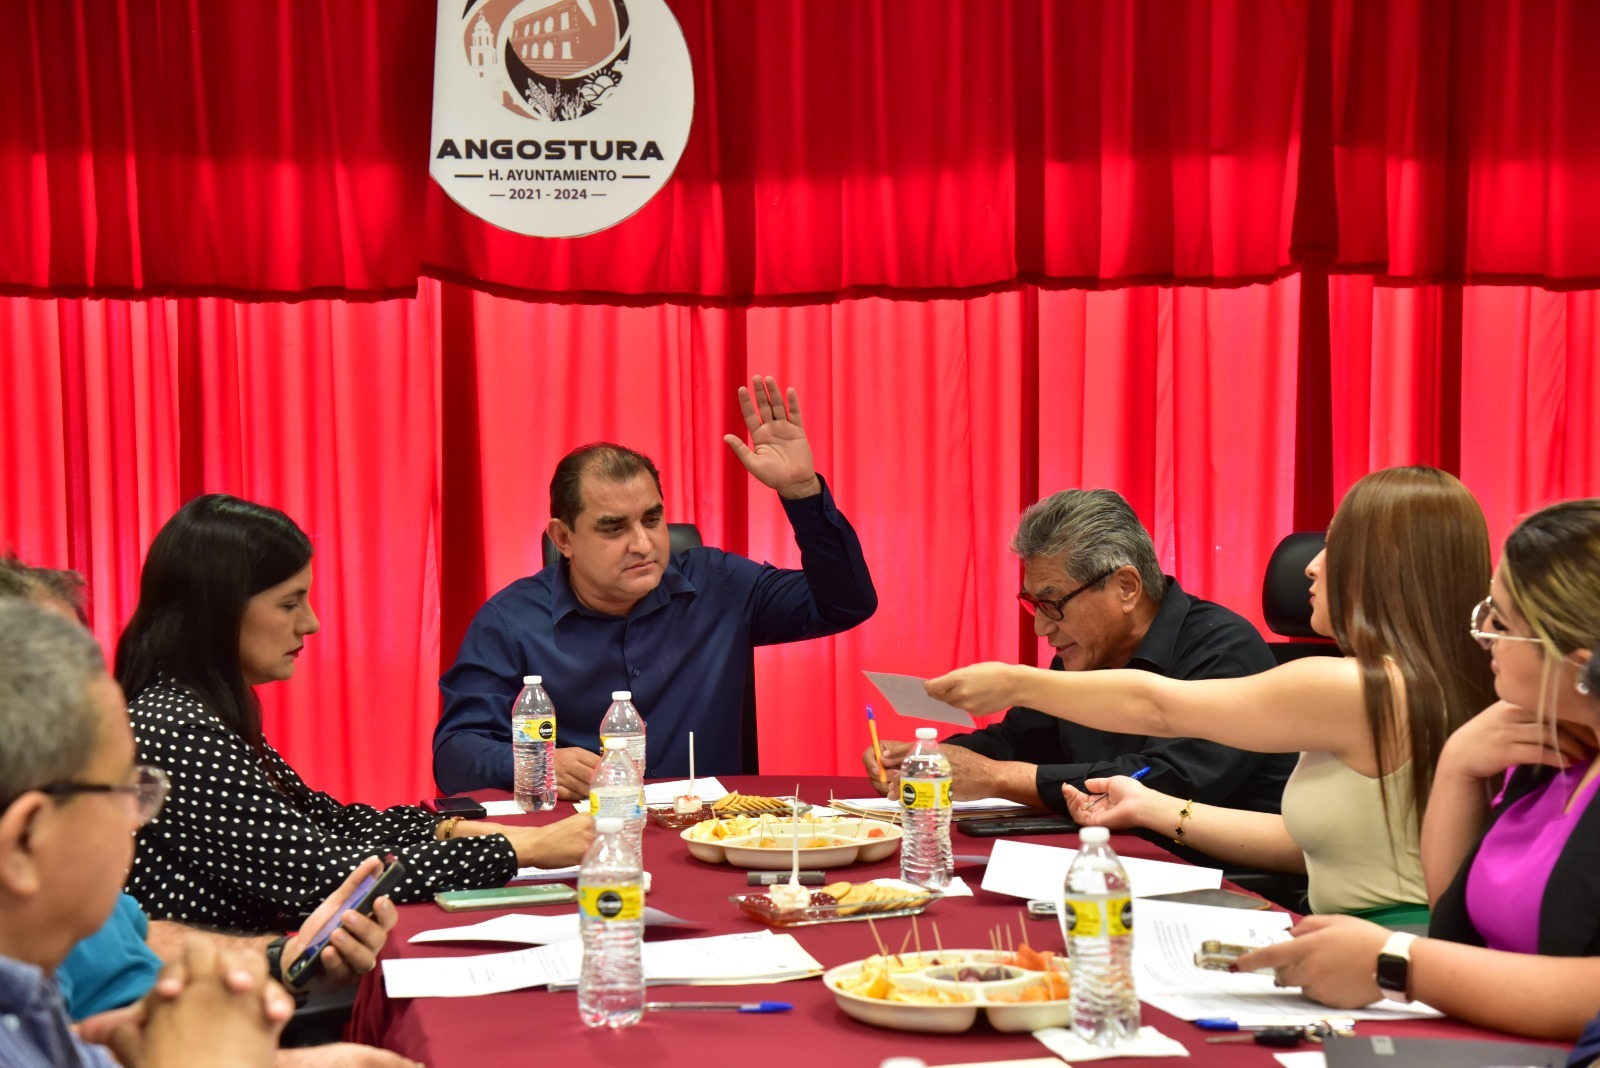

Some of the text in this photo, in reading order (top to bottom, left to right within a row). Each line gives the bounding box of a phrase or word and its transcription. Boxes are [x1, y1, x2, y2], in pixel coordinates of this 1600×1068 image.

[436, 138, 664, 161] ANGOSTURA
[488, 169, 617, 182] H. AYUNTAMIENTO
[508, 188, 542, 200] 2021
[554, 188, 588, 200] 2024
